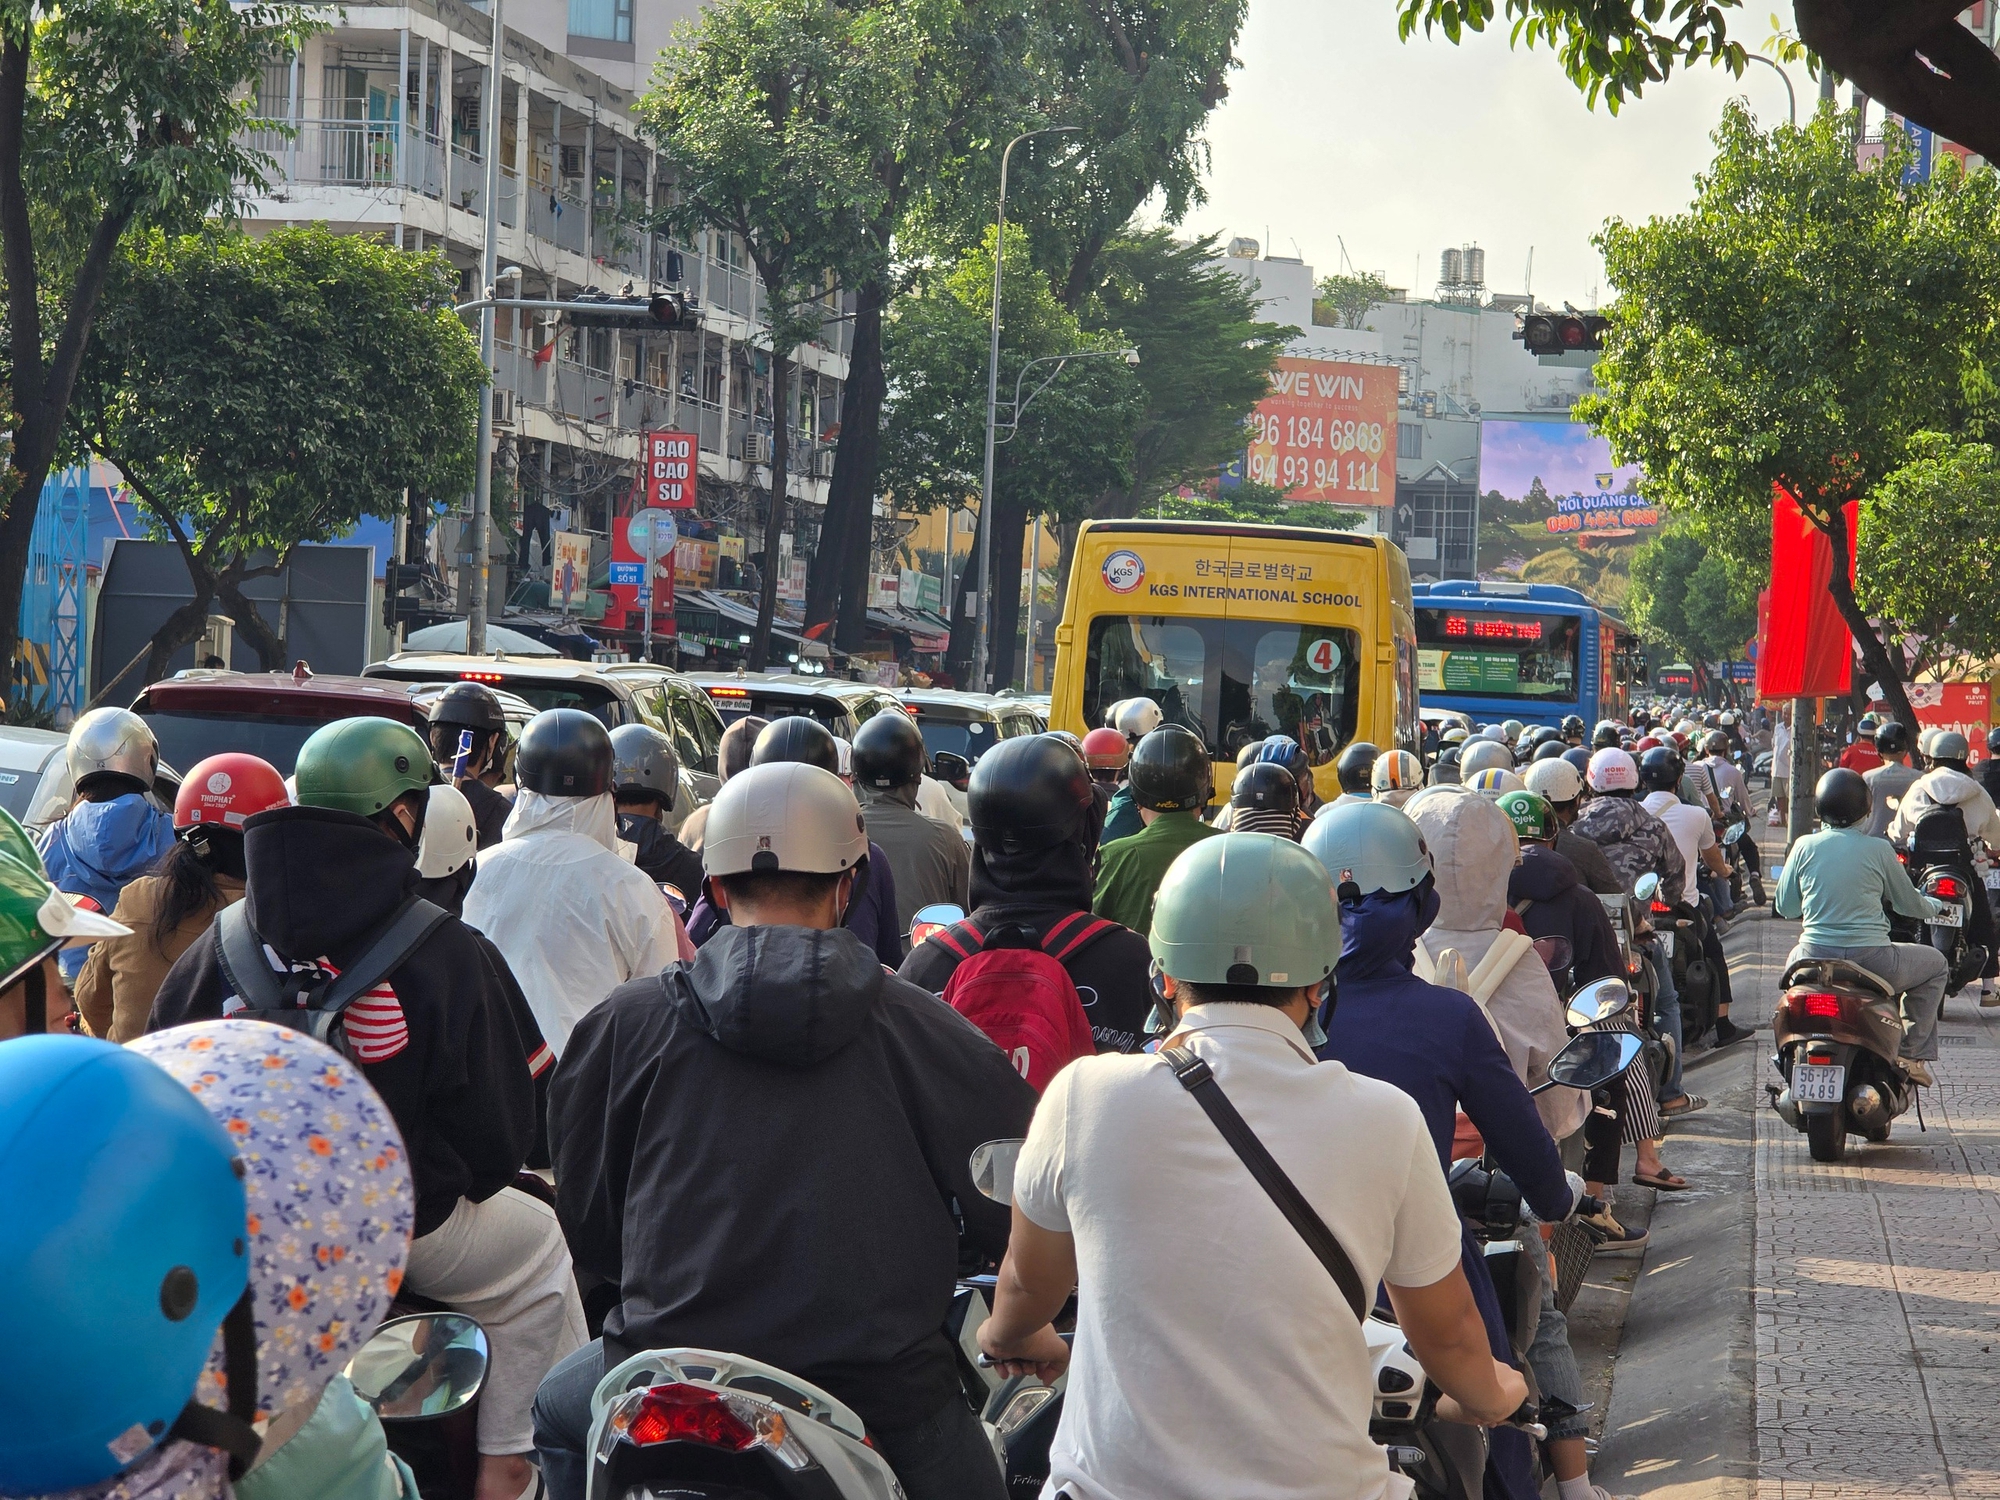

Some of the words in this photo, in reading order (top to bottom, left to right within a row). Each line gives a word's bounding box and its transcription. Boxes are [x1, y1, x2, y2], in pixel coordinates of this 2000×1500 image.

[1268, 370, 1310, 397] WE
[1313, 373, 1364, 401] WIN
[1271, 399, 1295, 408] working
[1297, 401, 1324, 411] together
[1286, 416, 1324, 449] 184
[1330, 419, 1382, 453] 6868
[654, 440, 690, 458] BAO
[654, 461, 689, 480] CAO
[1283, 455, 1309, 488] 93
[1314, 458, 1340, 489] 94
[1346, 460, 1380, 492] 111
[658, 483, 683, 501] SU
[1557, 495, 1581, 512] MỜI
[1582, 492, 1628, 510] QUẢNG
[1546, 513, 1581, 533] 090
[1584, 511, 1620, 528] 464
[1622, 509, 1658, 526] 6699
[617, 573, 628, 583] SỐ
[629, 575, 637, 583] 51
[1113, 567, 1133, 577] KGS
[1195, 558, 1313, 582] 한국글로벌학교
[1150, 584, 1179, 597] KGS
[1183, 585, 1298, 603] INTERNATIONAL
[1302, 592, 1363, 608] SCHOOL
[1314, 642, 1333, 670] 4
[200, 794, 233, 804] THOPHAT
[1511, 814, 1536, 825] ojek
[1800, 1068, 1837, 1083] 56-P2
[1799, 1084, 1836, 1099] 3489
